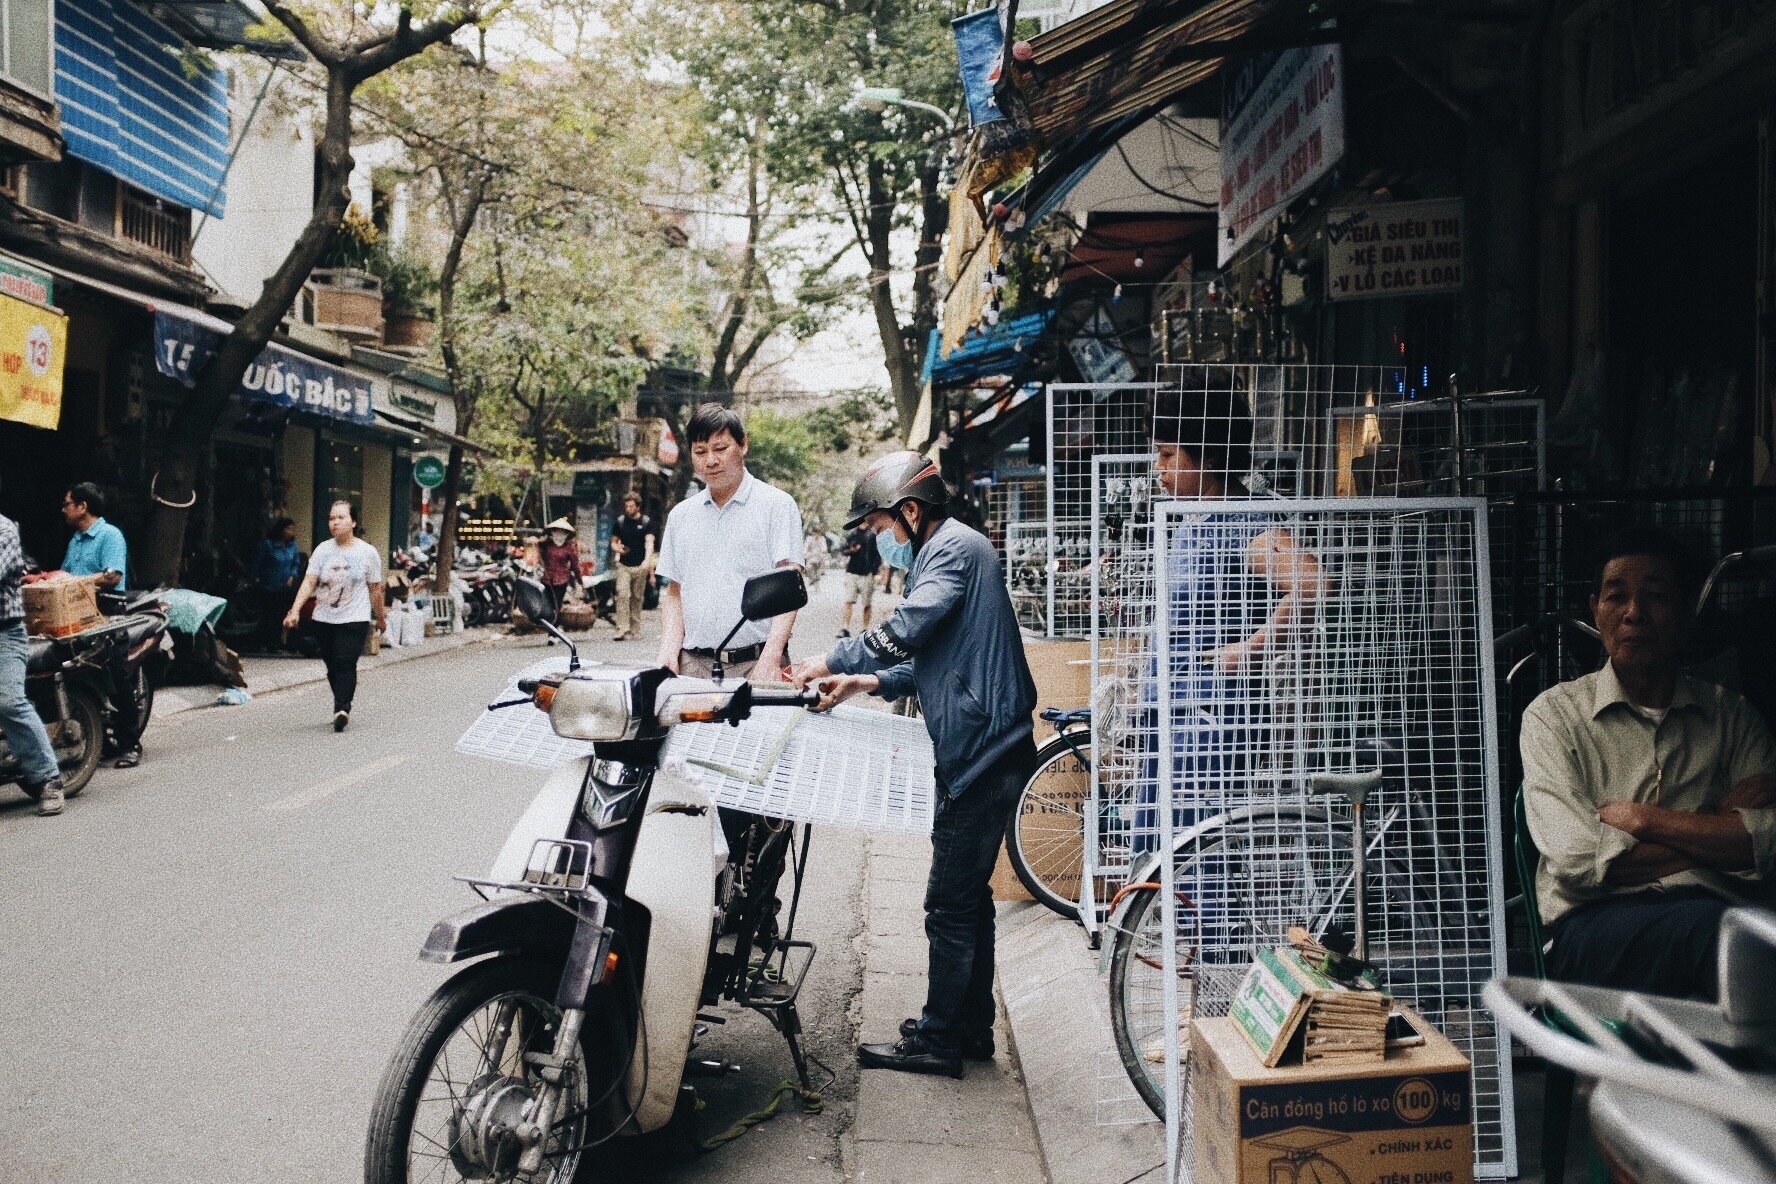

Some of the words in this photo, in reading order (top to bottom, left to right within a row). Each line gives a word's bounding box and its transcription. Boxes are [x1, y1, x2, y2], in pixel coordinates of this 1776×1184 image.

[30, 339, 48, 368] 13
[1372, 1098, 1390, 1112] xo
[1402, 1089, 1430, 1110] 100
[1442, 1090, 1461, 1110] kg
